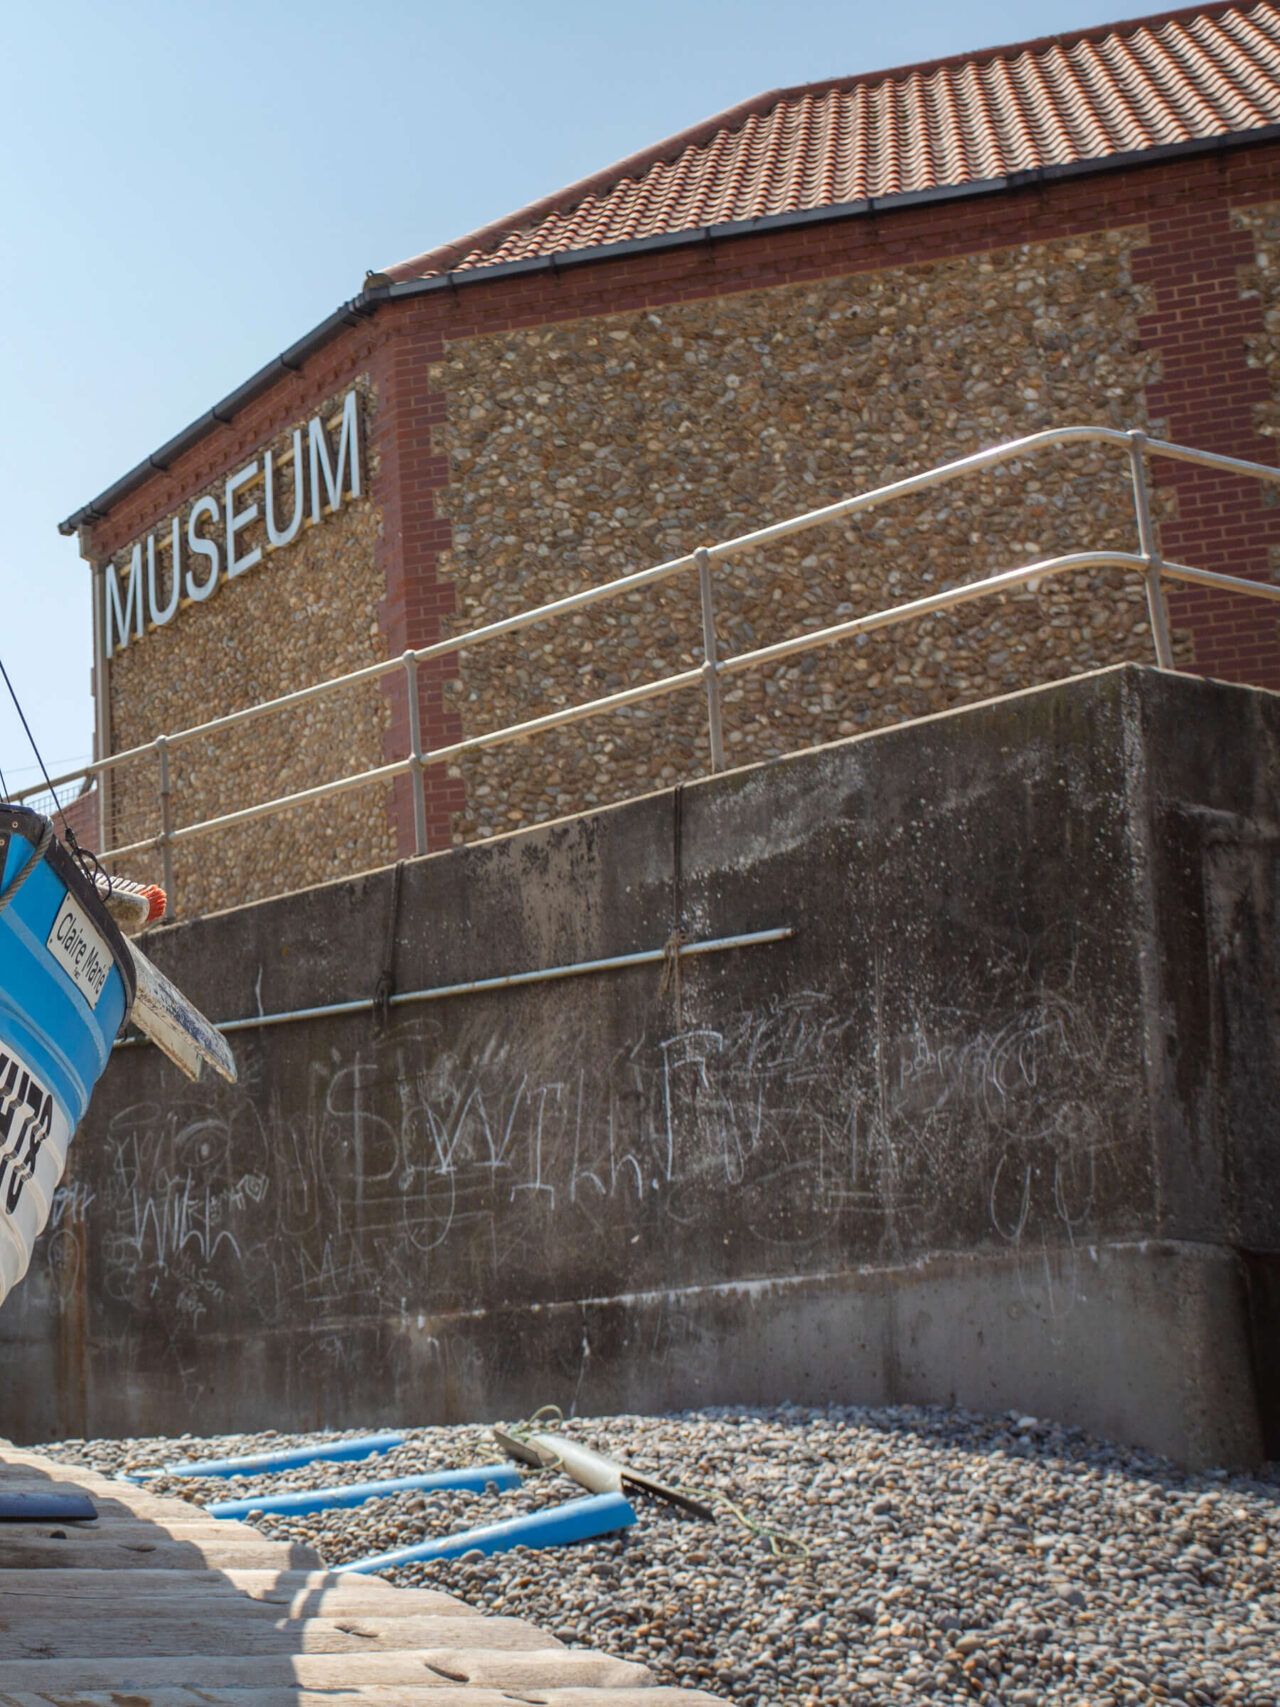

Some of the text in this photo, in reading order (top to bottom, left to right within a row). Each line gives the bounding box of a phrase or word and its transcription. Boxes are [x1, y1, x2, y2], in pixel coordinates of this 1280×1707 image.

[106, 390, 360, 659] MUSEUM
[57, 912, 106, 994] Claire Marie
